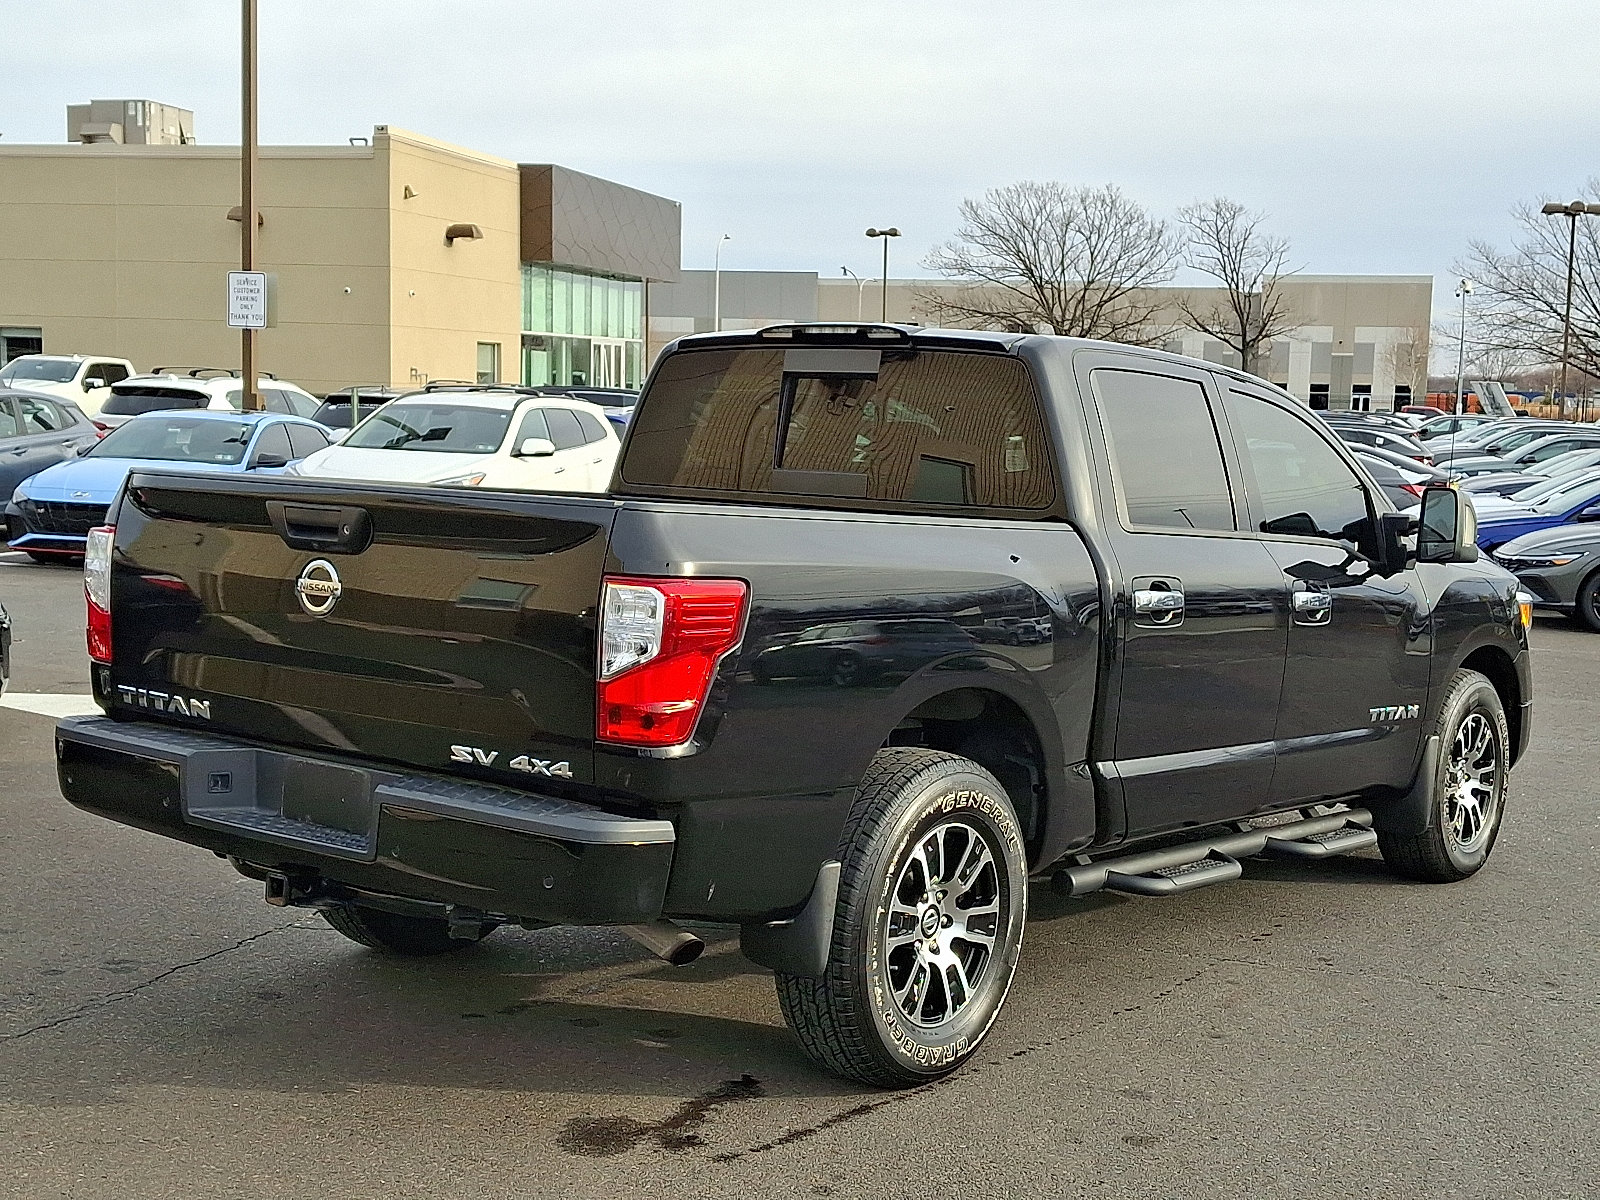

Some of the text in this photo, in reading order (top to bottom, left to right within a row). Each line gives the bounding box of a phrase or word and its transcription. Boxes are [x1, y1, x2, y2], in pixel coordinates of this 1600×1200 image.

[230, 312, 263, 321] THANK YOU
[301, 582, 335, 593] NISSAN
[117, 684, 211, 720] TITAN
[1369, 704, 1420, 722] TITAN
[450, 744, 499, 767] SV
[942, 789, 1020, 852] GENERAL
[882, 1007, 969, 1067] GRABBER
